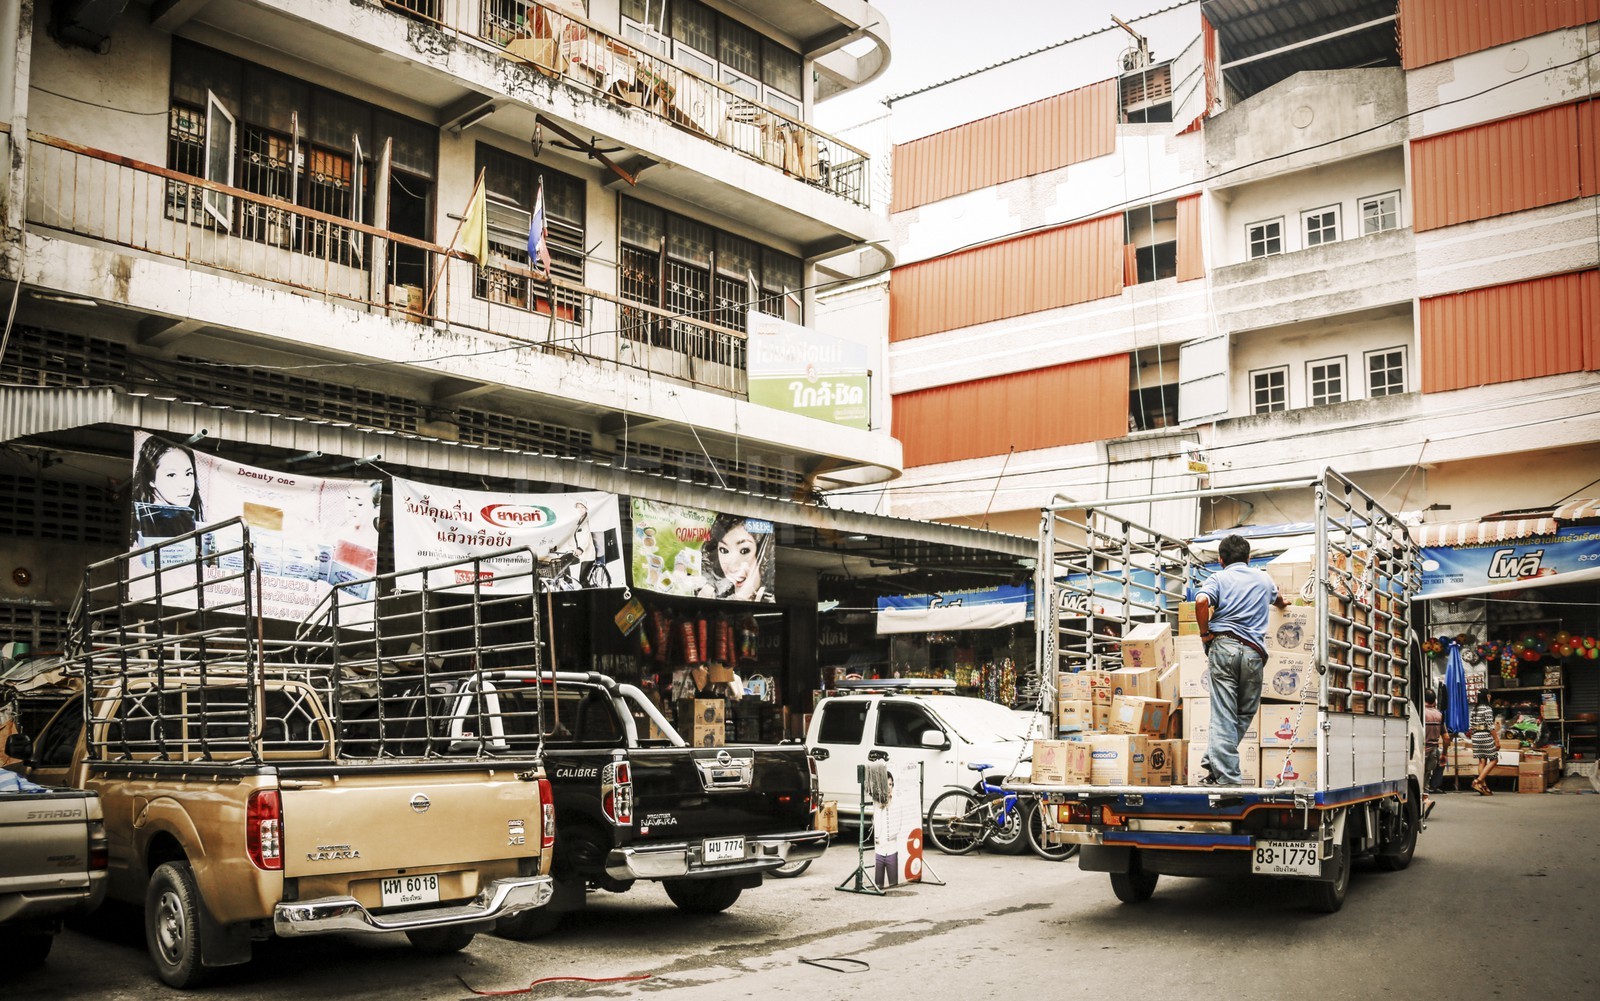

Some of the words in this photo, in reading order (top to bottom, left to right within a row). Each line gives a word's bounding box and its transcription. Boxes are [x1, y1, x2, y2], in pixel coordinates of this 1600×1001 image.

[236, 466, 275, 486] Beauty
[277, 476, 296, 487] one
[497, 508, 542, 525] ยาคูลท์
[436, 526, 513, 548] แล้วหรือยัง
[1487, 548, 1545, 579] โพลี
[556, 768, 598, 778] CALIBRE
[27, 809, 82, 819] STRADA
[640, 817, 678, 827] NAVARA
[508, 836, 526, 846] XE
[724, 840, 743, 851] 7774
[306, 849, 361, 862] NAVARA
[1256, 848, 1317, 865] 83-1779
[406, 876, 437, 892] 6018
